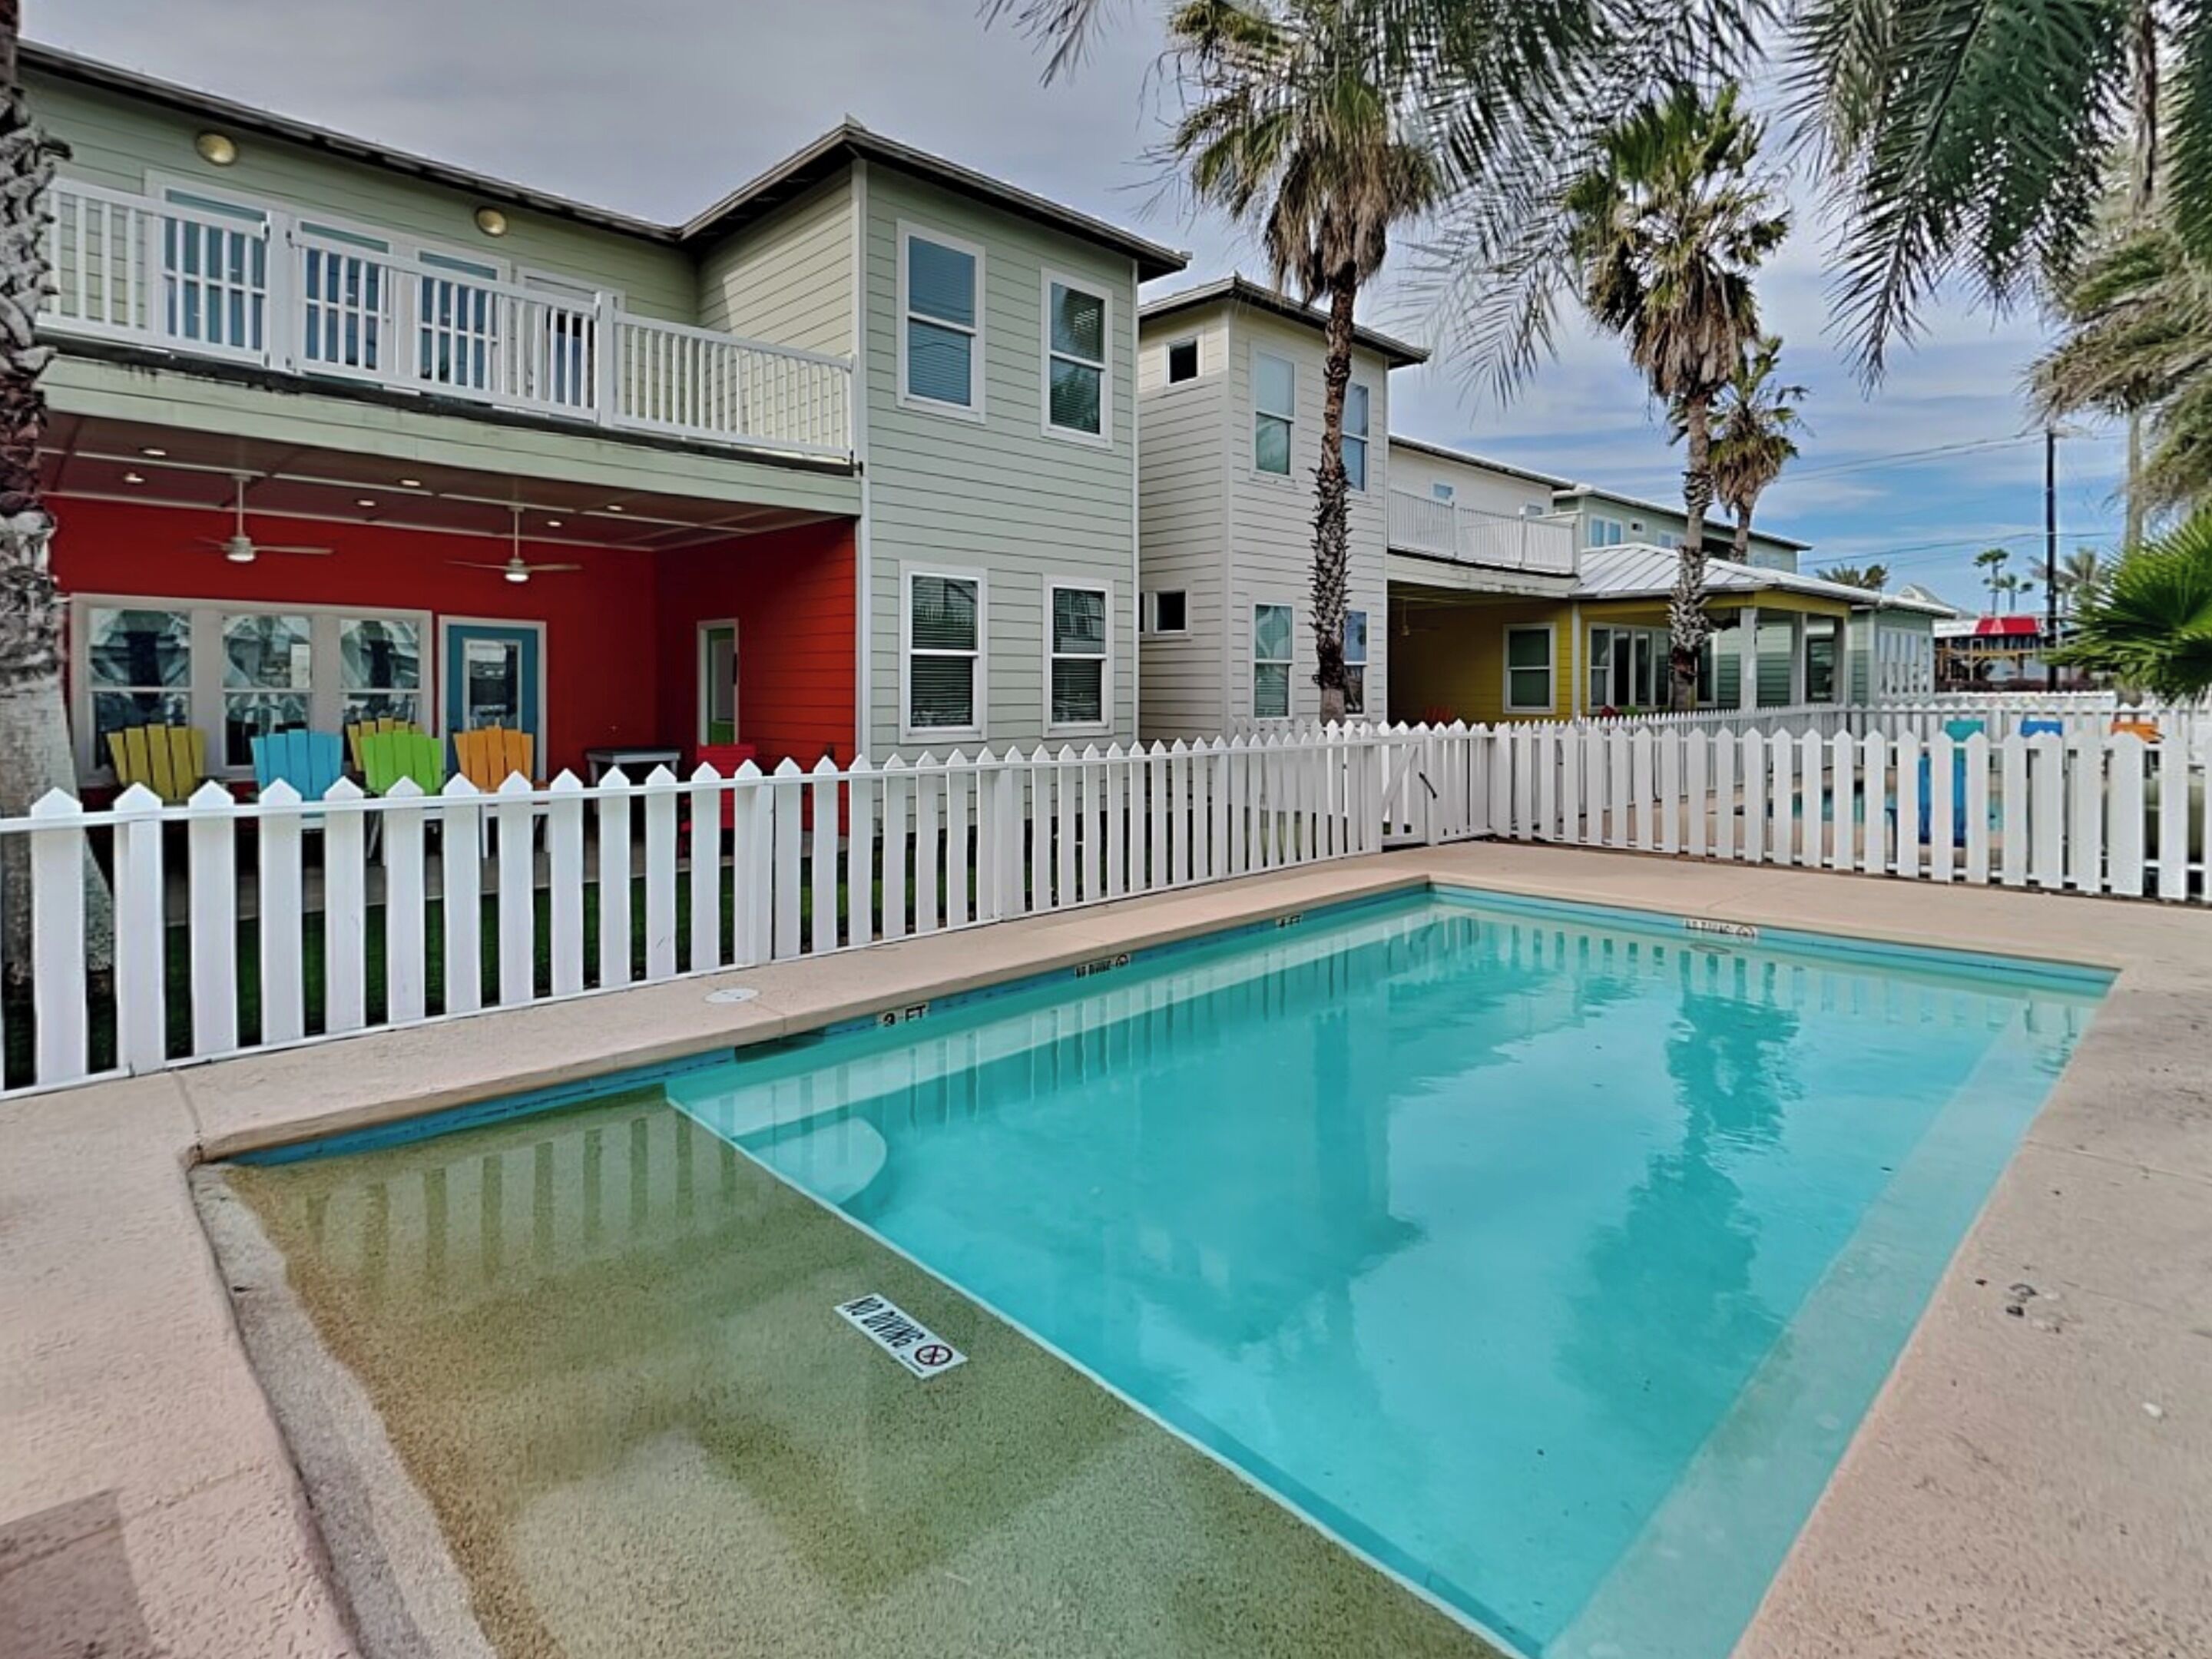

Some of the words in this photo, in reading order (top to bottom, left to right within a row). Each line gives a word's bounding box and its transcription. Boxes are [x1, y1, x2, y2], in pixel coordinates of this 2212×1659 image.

[905, 1003, 926, 1022] FT
[843, 1297, 884, 1316] NO
[862, 1310, 926, 1349] DIVING
